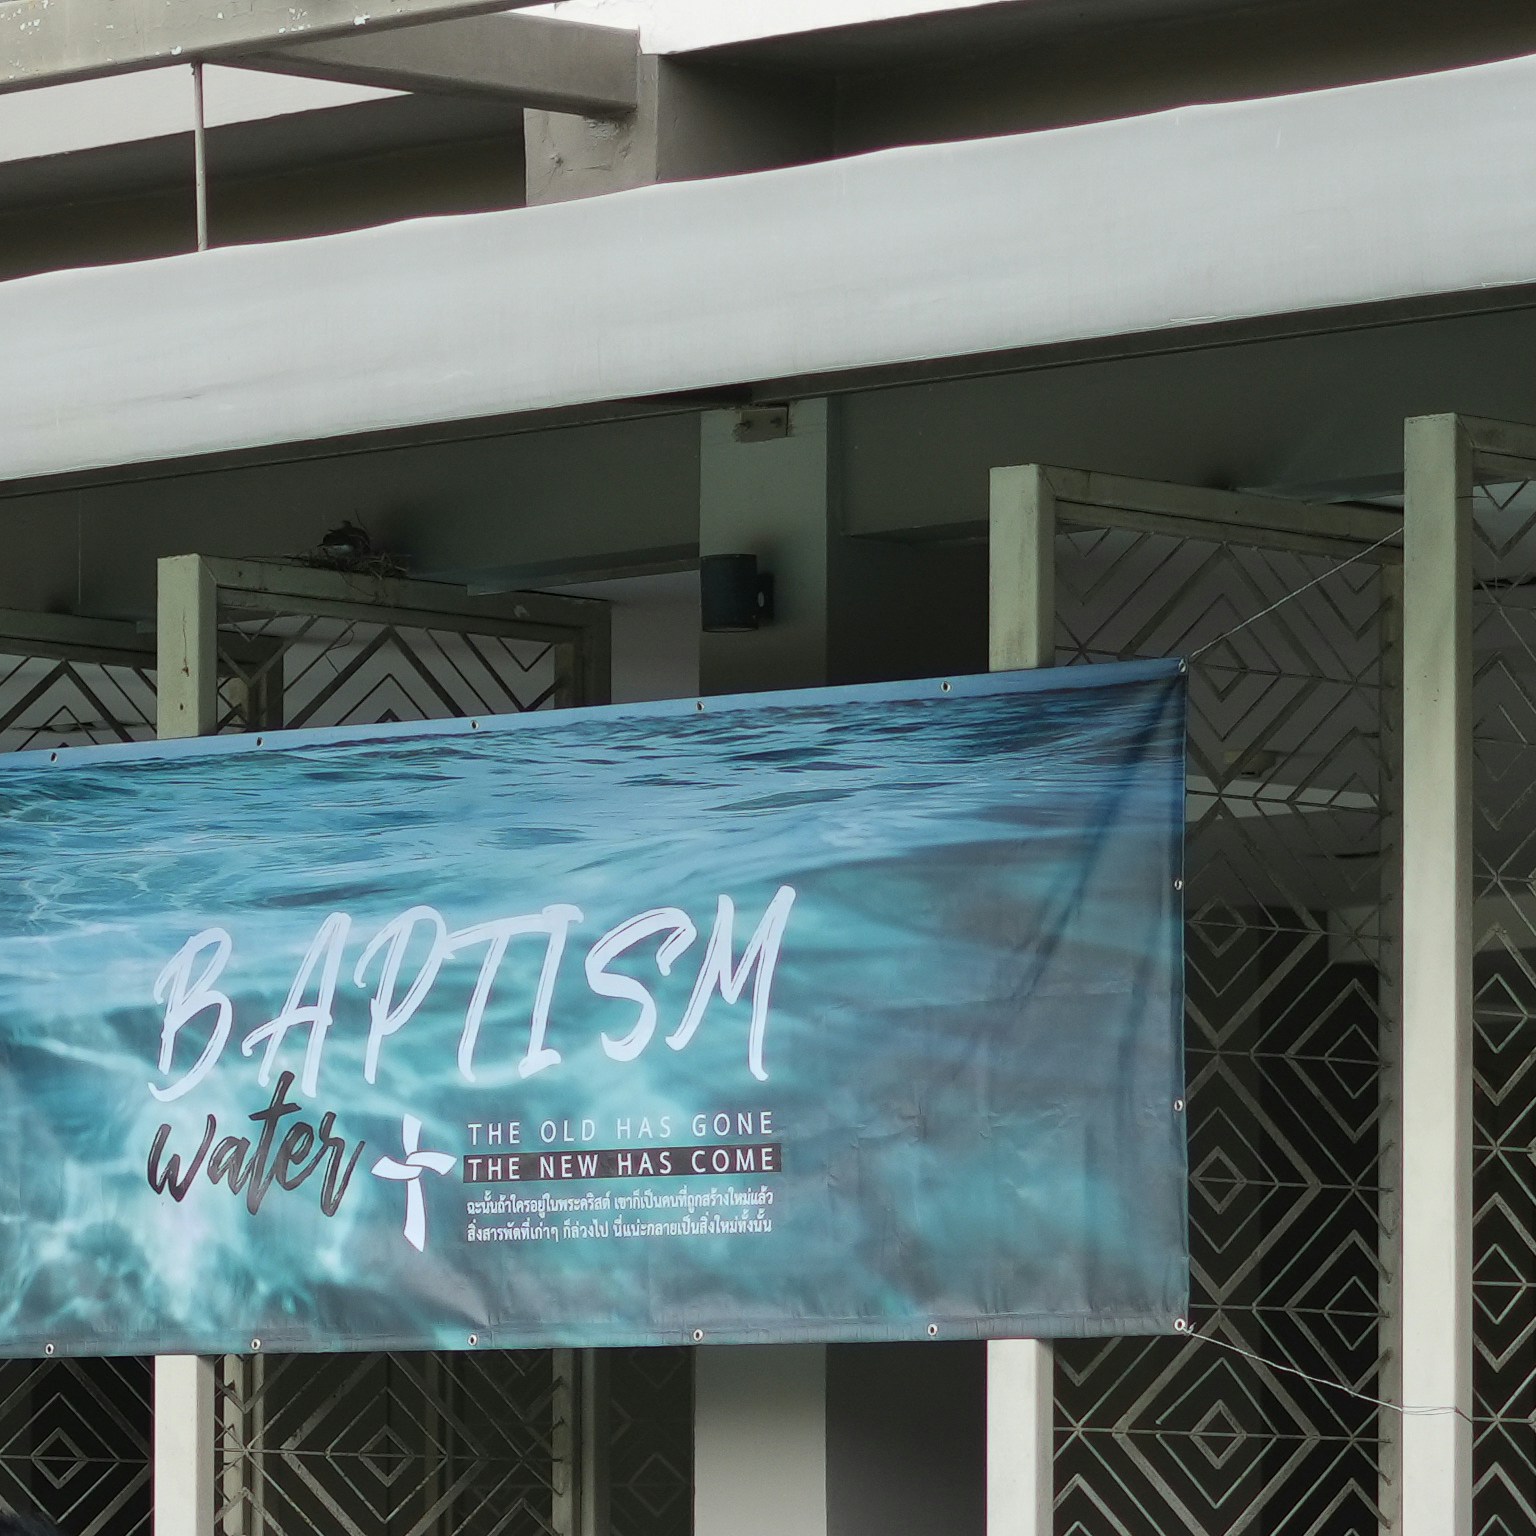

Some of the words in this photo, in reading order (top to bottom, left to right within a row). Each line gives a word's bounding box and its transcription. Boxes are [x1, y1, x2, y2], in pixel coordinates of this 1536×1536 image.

[149, 885, 796, 1101] BAPTISM
[147, 1071, 365, 1217] water
[467, 1157, 520, 1181] THE
[539, 1154, 599, 1179] NEW
[617, 1151, 672, 1177] HAS
[691, 1147, 773, 1173] COME
[468, 1121, 520, 1145] THE
[540, 1119, 595, 1143] OLD
[617, 1116, 671, 1139] HAS
[692, 1111, 772, 1137] GONE
